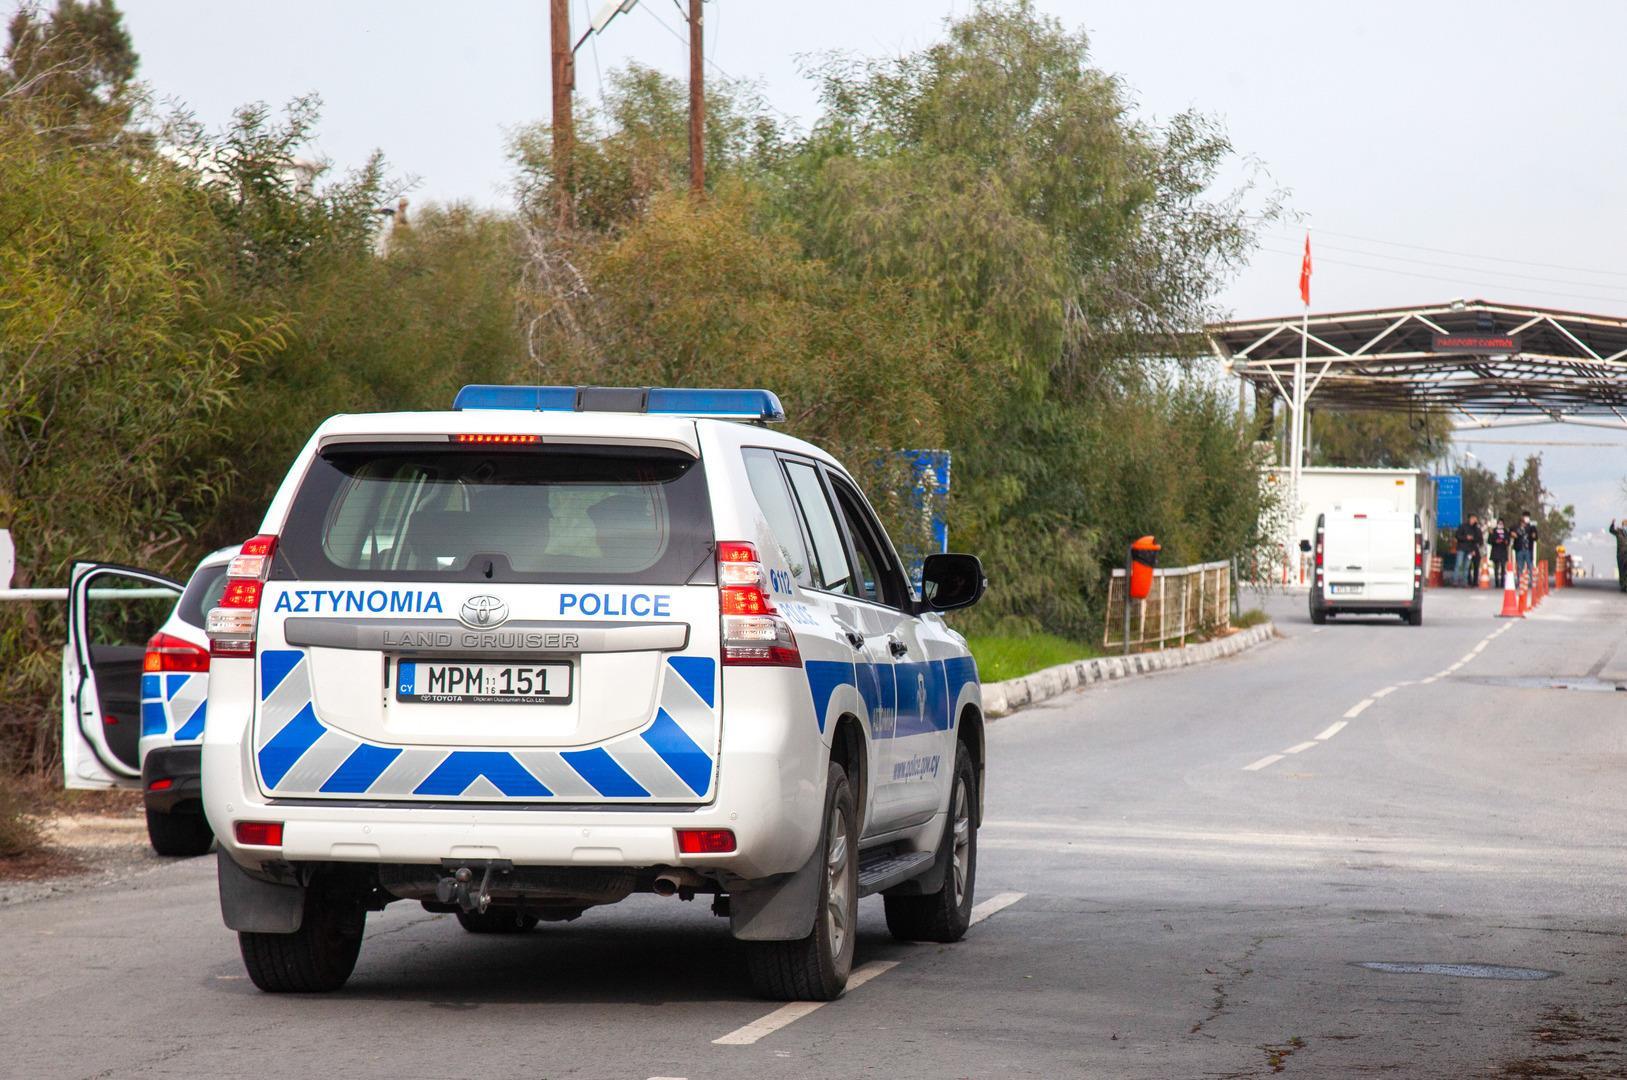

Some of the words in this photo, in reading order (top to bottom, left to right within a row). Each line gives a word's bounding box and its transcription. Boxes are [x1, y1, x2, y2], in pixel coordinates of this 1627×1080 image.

[274, 590, 443, 613] ΑΣΤΥΝΟΜΙΑ
[559, 592, 671, 617] POLICE
[383, 630, 452, 648] LAND
[461, 632, 579, 649] CRUISER
[400, 684, 413, 692] CY
[428, 666, 483, 694] MPM
[500, 668, 550, 695] 151
